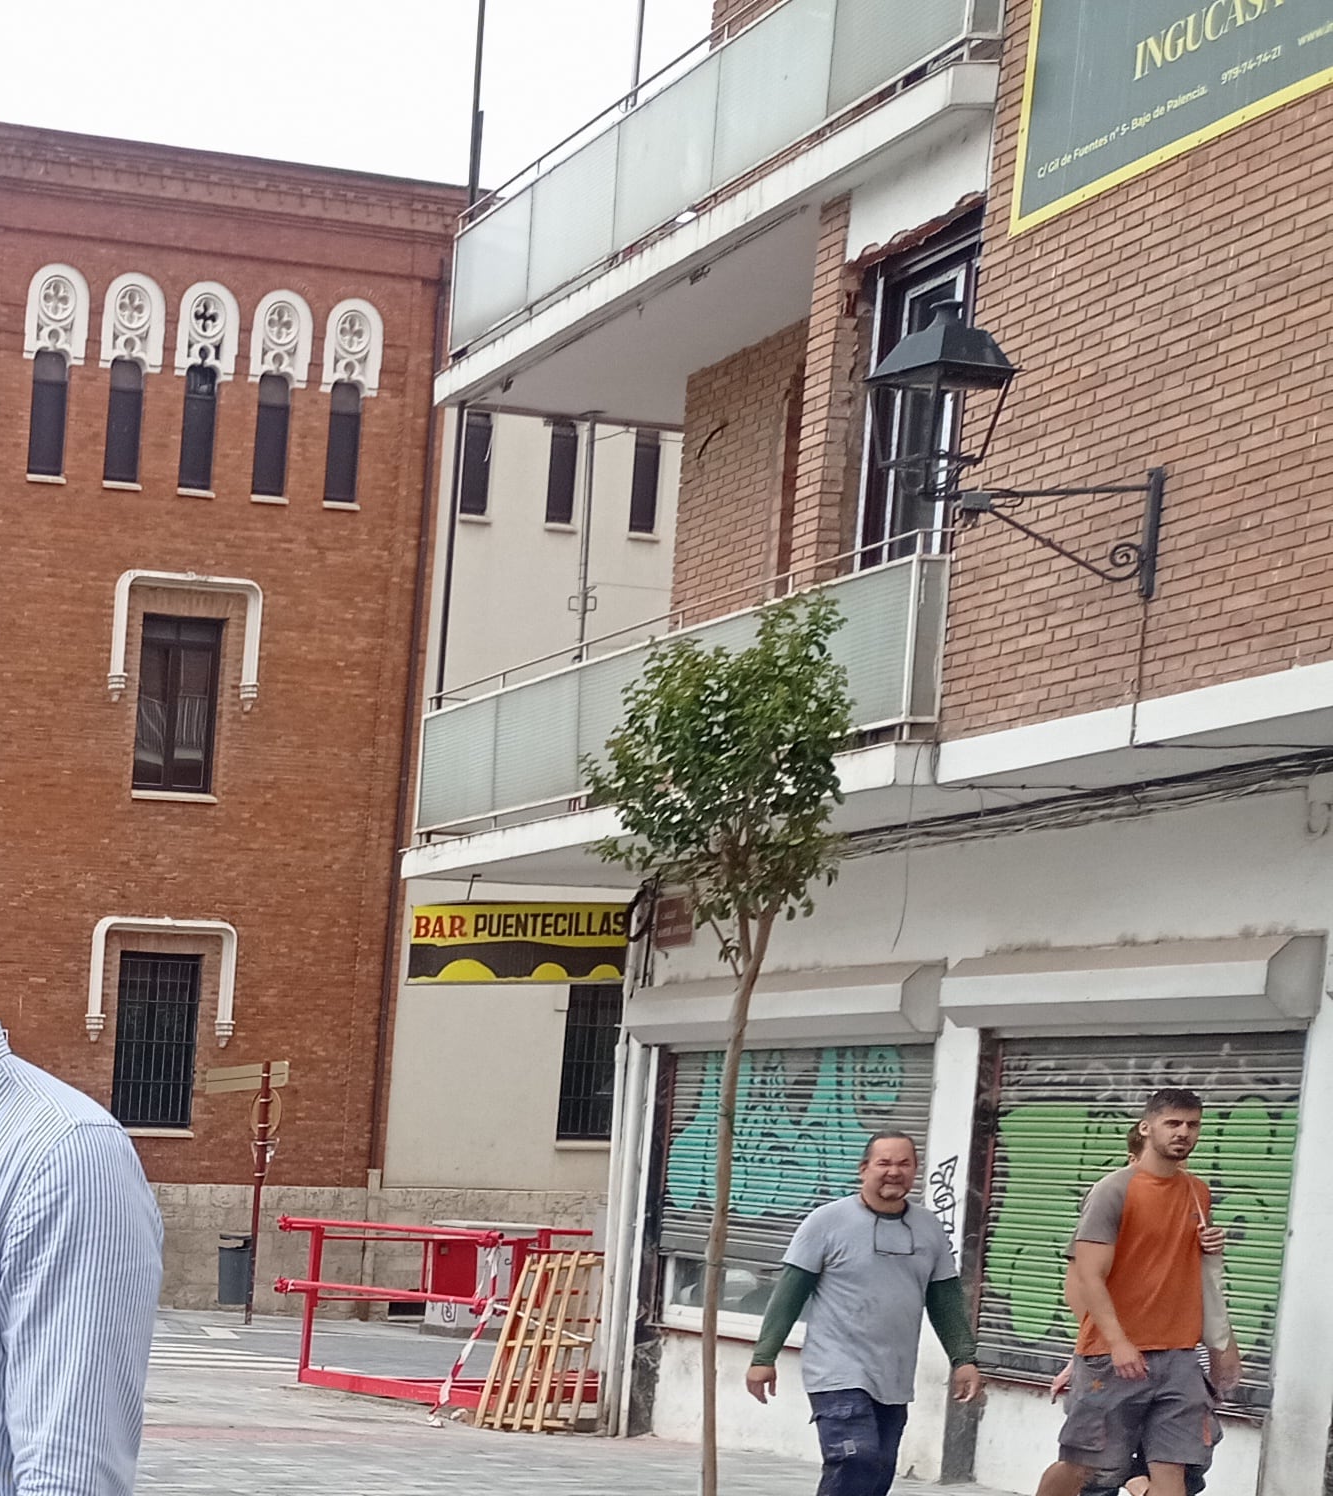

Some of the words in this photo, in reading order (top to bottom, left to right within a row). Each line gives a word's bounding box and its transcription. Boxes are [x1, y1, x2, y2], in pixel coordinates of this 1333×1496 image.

[1047, 157, 1060, 173] Gil
[1060, 152, 1073, 167] de
[1073, 135, 1108, 160] Fuentes
[1131, 111, 1151, 130] Bajo
[1152, 105, 1165, 119] de
[413, 915, 467, 938] BAR
[473, 911, 628, 938] PUENTECILLAS
